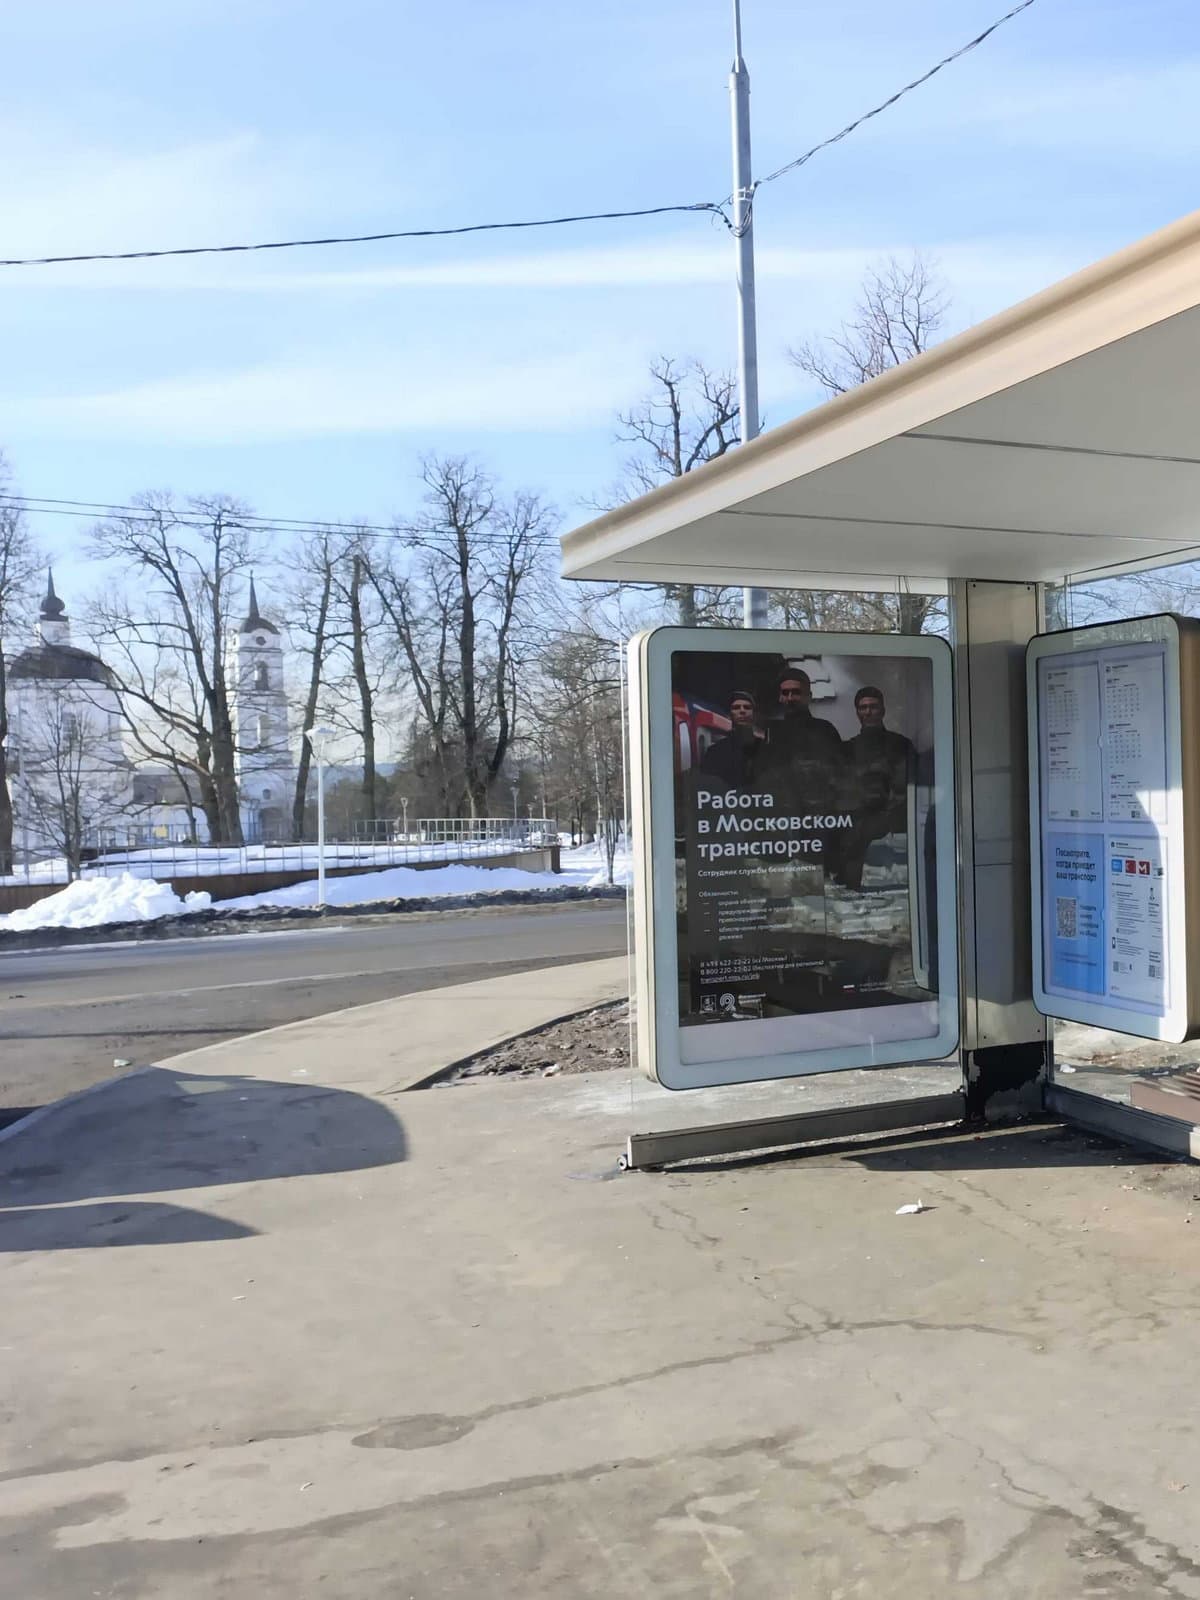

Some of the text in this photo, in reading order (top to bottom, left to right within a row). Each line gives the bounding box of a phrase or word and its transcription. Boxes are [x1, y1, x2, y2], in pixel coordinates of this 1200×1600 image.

[697, 789, 774, 809] Работа
[697, 814, 853, 833] в Московском
[697, 838, 823, 861] транспорте
[698, 869, 738, 878] Сотрудник
[739, 867, 767, 876] службы
